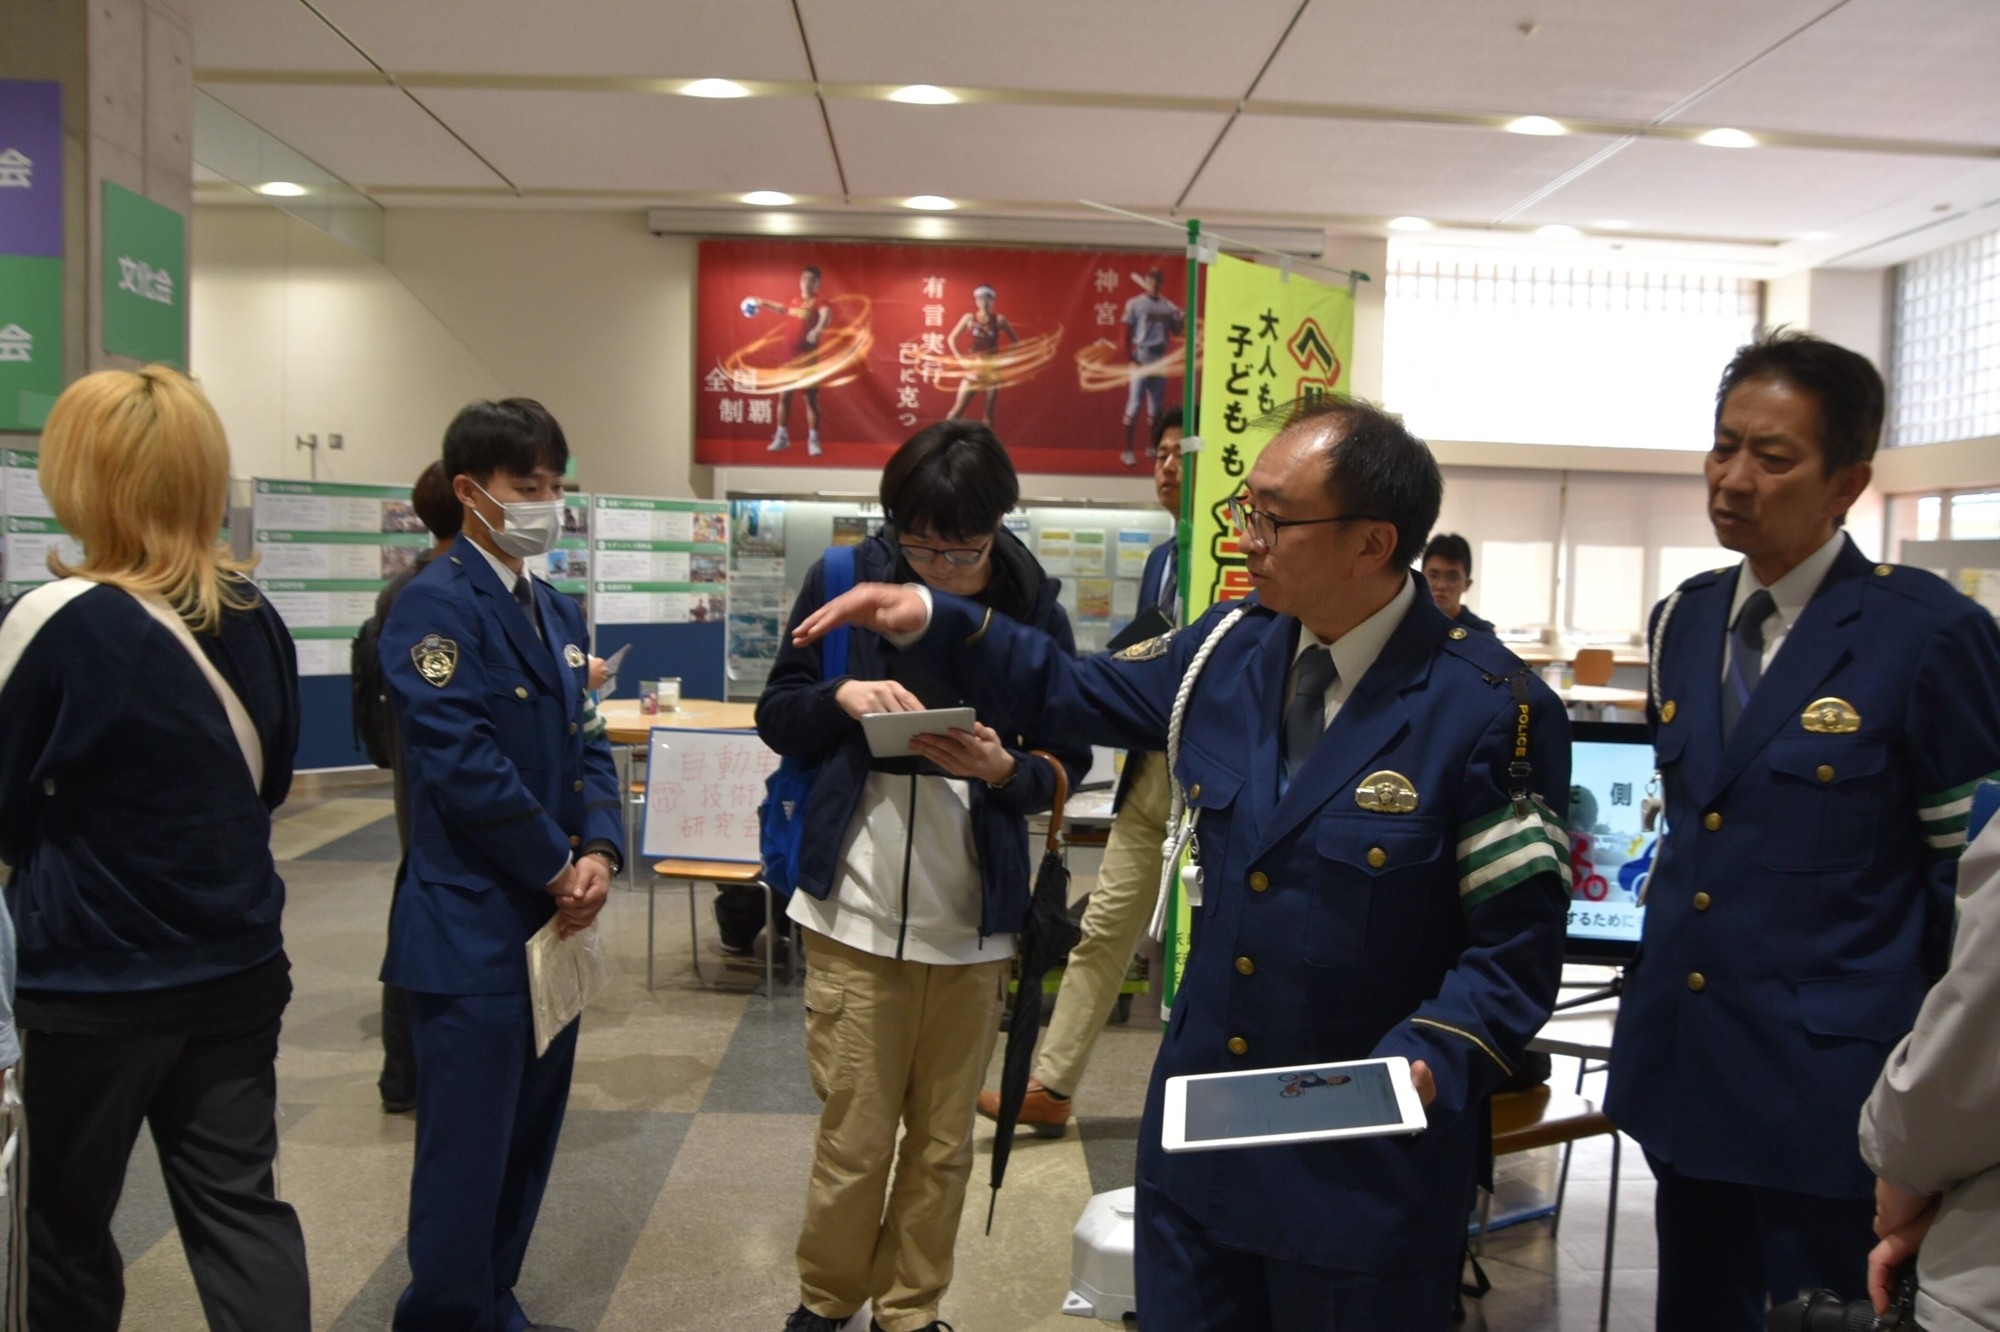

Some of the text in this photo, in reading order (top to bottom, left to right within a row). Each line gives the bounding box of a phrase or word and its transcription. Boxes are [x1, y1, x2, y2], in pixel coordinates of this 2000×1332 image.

[1093, 267, 1119, 350] 神宮へ
[704, 367, 757, 392] 全国
[897, 342, 920, 426] 己に克つ
[1221, 324, 1254, 477] 子どもも
[1258, 308, 1279, 414] 大人も
[719, 398, 772, 424] 制覇
[1515, 704, 1529, 757] POLICE
